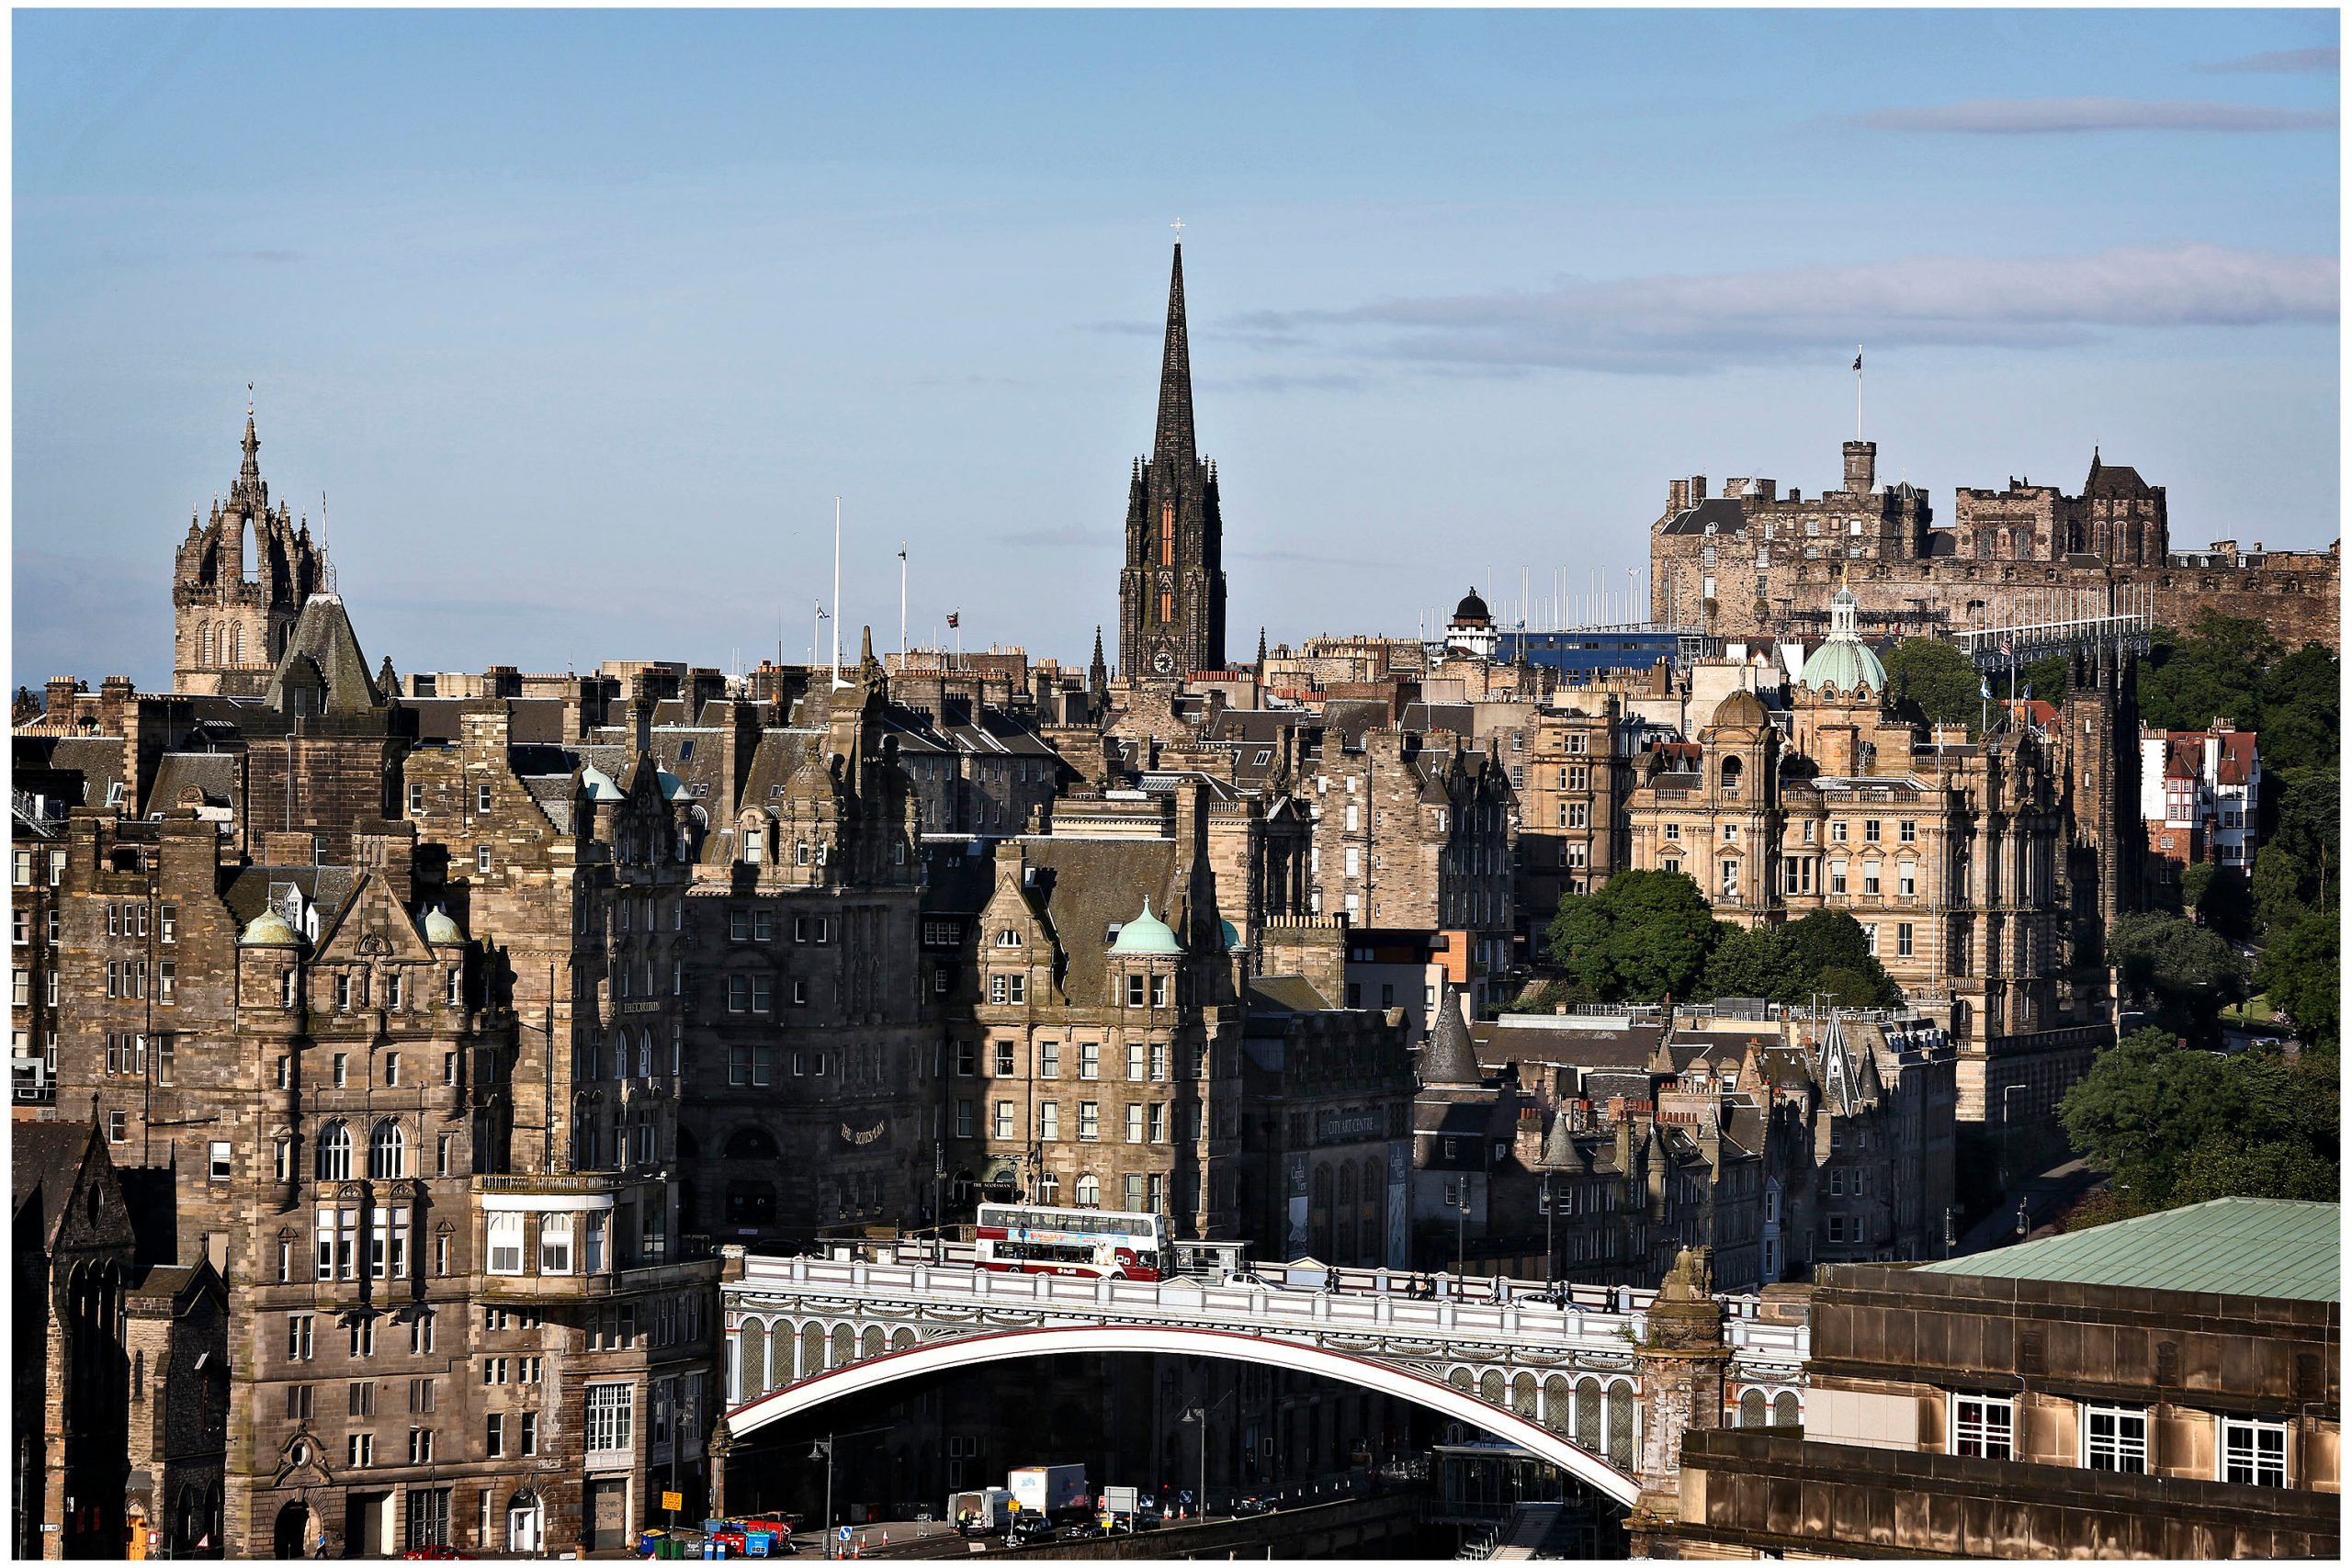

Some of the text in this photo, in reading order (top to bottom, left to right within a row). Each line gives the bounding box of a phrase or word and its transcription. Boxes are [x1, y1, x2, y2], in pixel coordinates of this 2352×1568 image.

[842, 1120, 885, 1145] THE SCOTSMAN
[1329, 1117, 1373, 1134] CITY ART CENTRE
